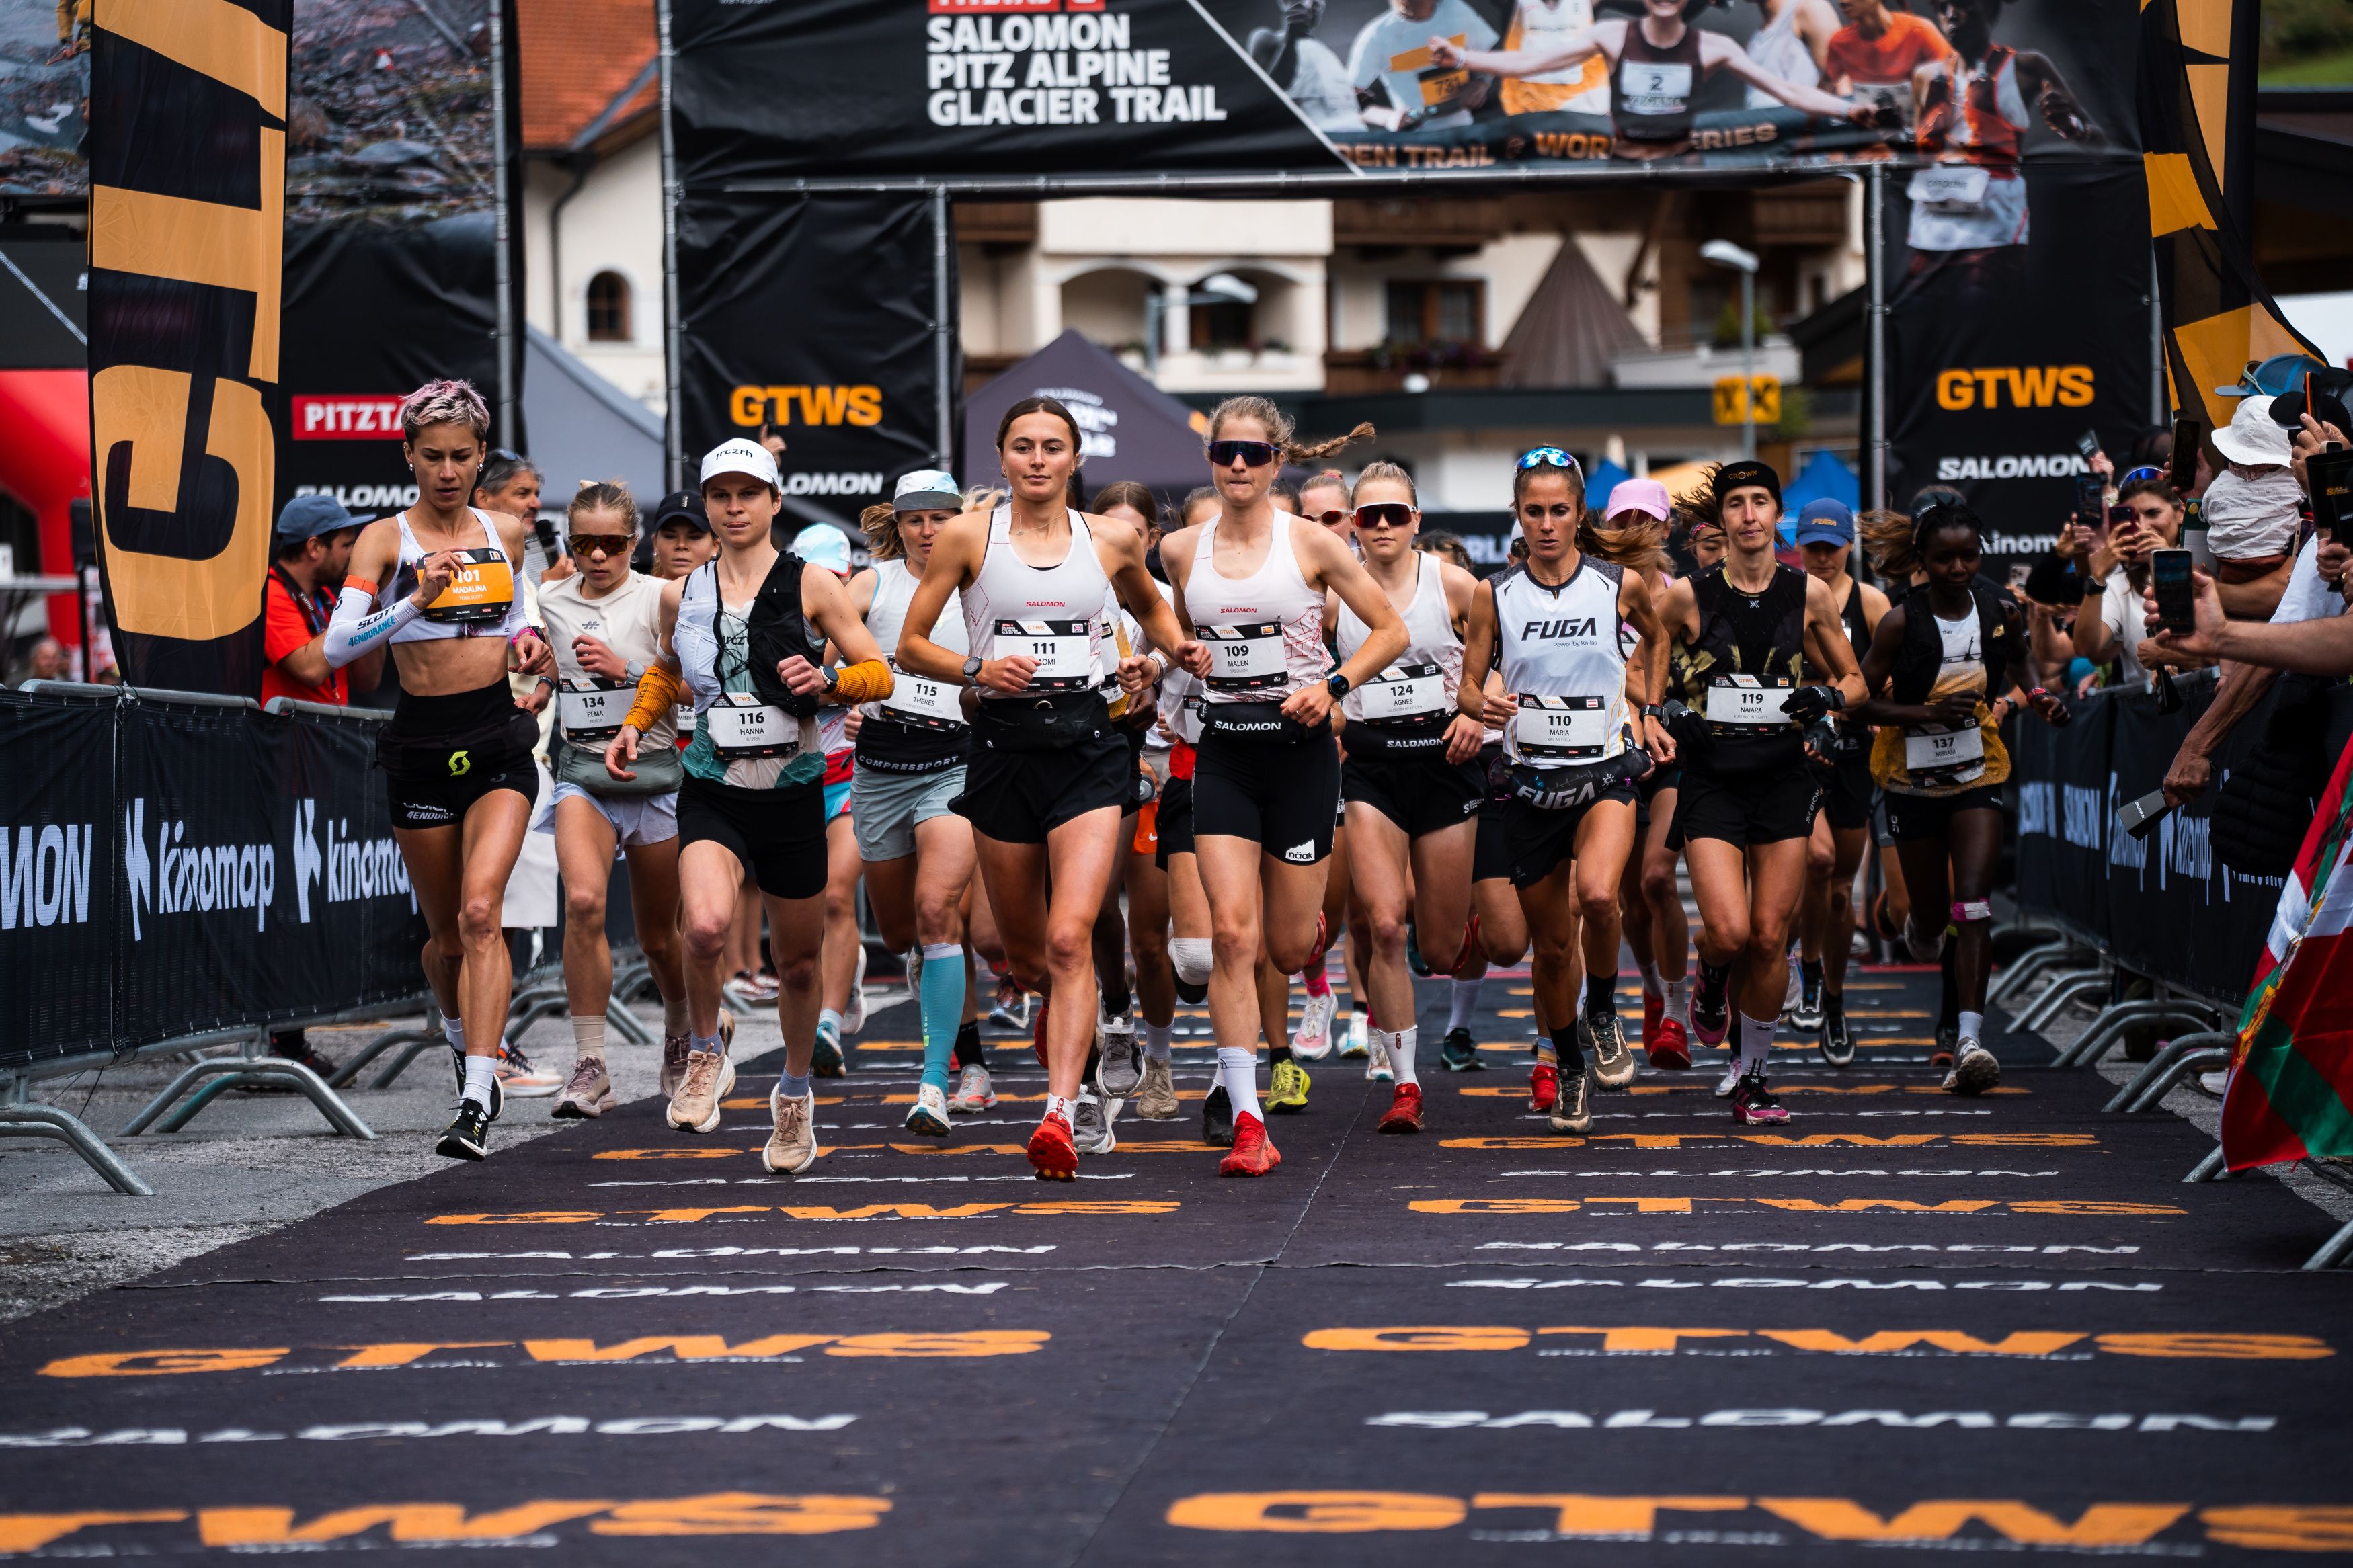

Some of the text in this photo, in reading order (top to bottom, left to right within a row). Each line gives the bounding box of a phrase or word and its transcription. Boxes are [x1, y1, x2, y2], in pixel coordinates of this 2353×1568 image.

[927, 15, 1131, 52] SALOMON
[928, 50, 1171, 89] PITZ ALPINE
[1651, 75, 1664, 91] 2
[927, 87, 1227, 126] GLACIER TRAIL
[1402, 144, 1497, 169] TRAIL
[1536, 132, 1612, 159] WOR
[1937, 365, 2095, 411] GTWS
[730, 385, 883, 427] GTWS
[304, 402, 404, 432] PITZT
[1937, 454, 2090, 480] SALOMON
[1728, 470, 1757, 480] CROWN
[779, 472, 885, 495] LOMON
[458, 569, 480, 583] 101
[452, 585, 487, 595] MADALINA
[357, 603, 399, 630] SCOTT
[1521, 618, 1597, 641] FUGA
[1032, 643, 1055, 654] 111
[1224, 645, 1249, 657] 109
[916, 684, 938, 697] 115
[1390, 684, 1414, 697] 124
[582, 696, 605, 708] 134
[914, 697, 935, 706] THERES
[1394, 698, 1413, 706] AGNES
[1741, 693, 1763, 704] 119
[739, 712, 764, 725] 116
[1214, 720, 1281, 731] SALOMON
[1548, 715, 1572, 726] 110
[1386, 739, 1444, 748] SALOMON
[1933, 737, 1954, 749] 137
[859, 755, 959, 771] COMPRESSPORT
[1516, 782, 1595, 810] FUGA
[2135, 801, 2145, 819] SALOMON
[1288, 850, 1313, 861] näak
[159, 817, 418, 932] kinomap kinoma
[1438, 1134, 2100, 1149] GTWS
[424, 1201, 1181, 1225] GTWS
[1408, 1197, 2189, 1215] GTWS
[1473, 1242, 2141, 1255] SALOMON
[1443, 1278, 2165, 1292] SALOMON
[35, 1329, 1051, 1378] GTWS
[1301, 1326, 2336, 1360] GTWS
[1365, 1409, 2276, 1432] SALOMON
[1166, 1489, 2353, 1552] GTWS
